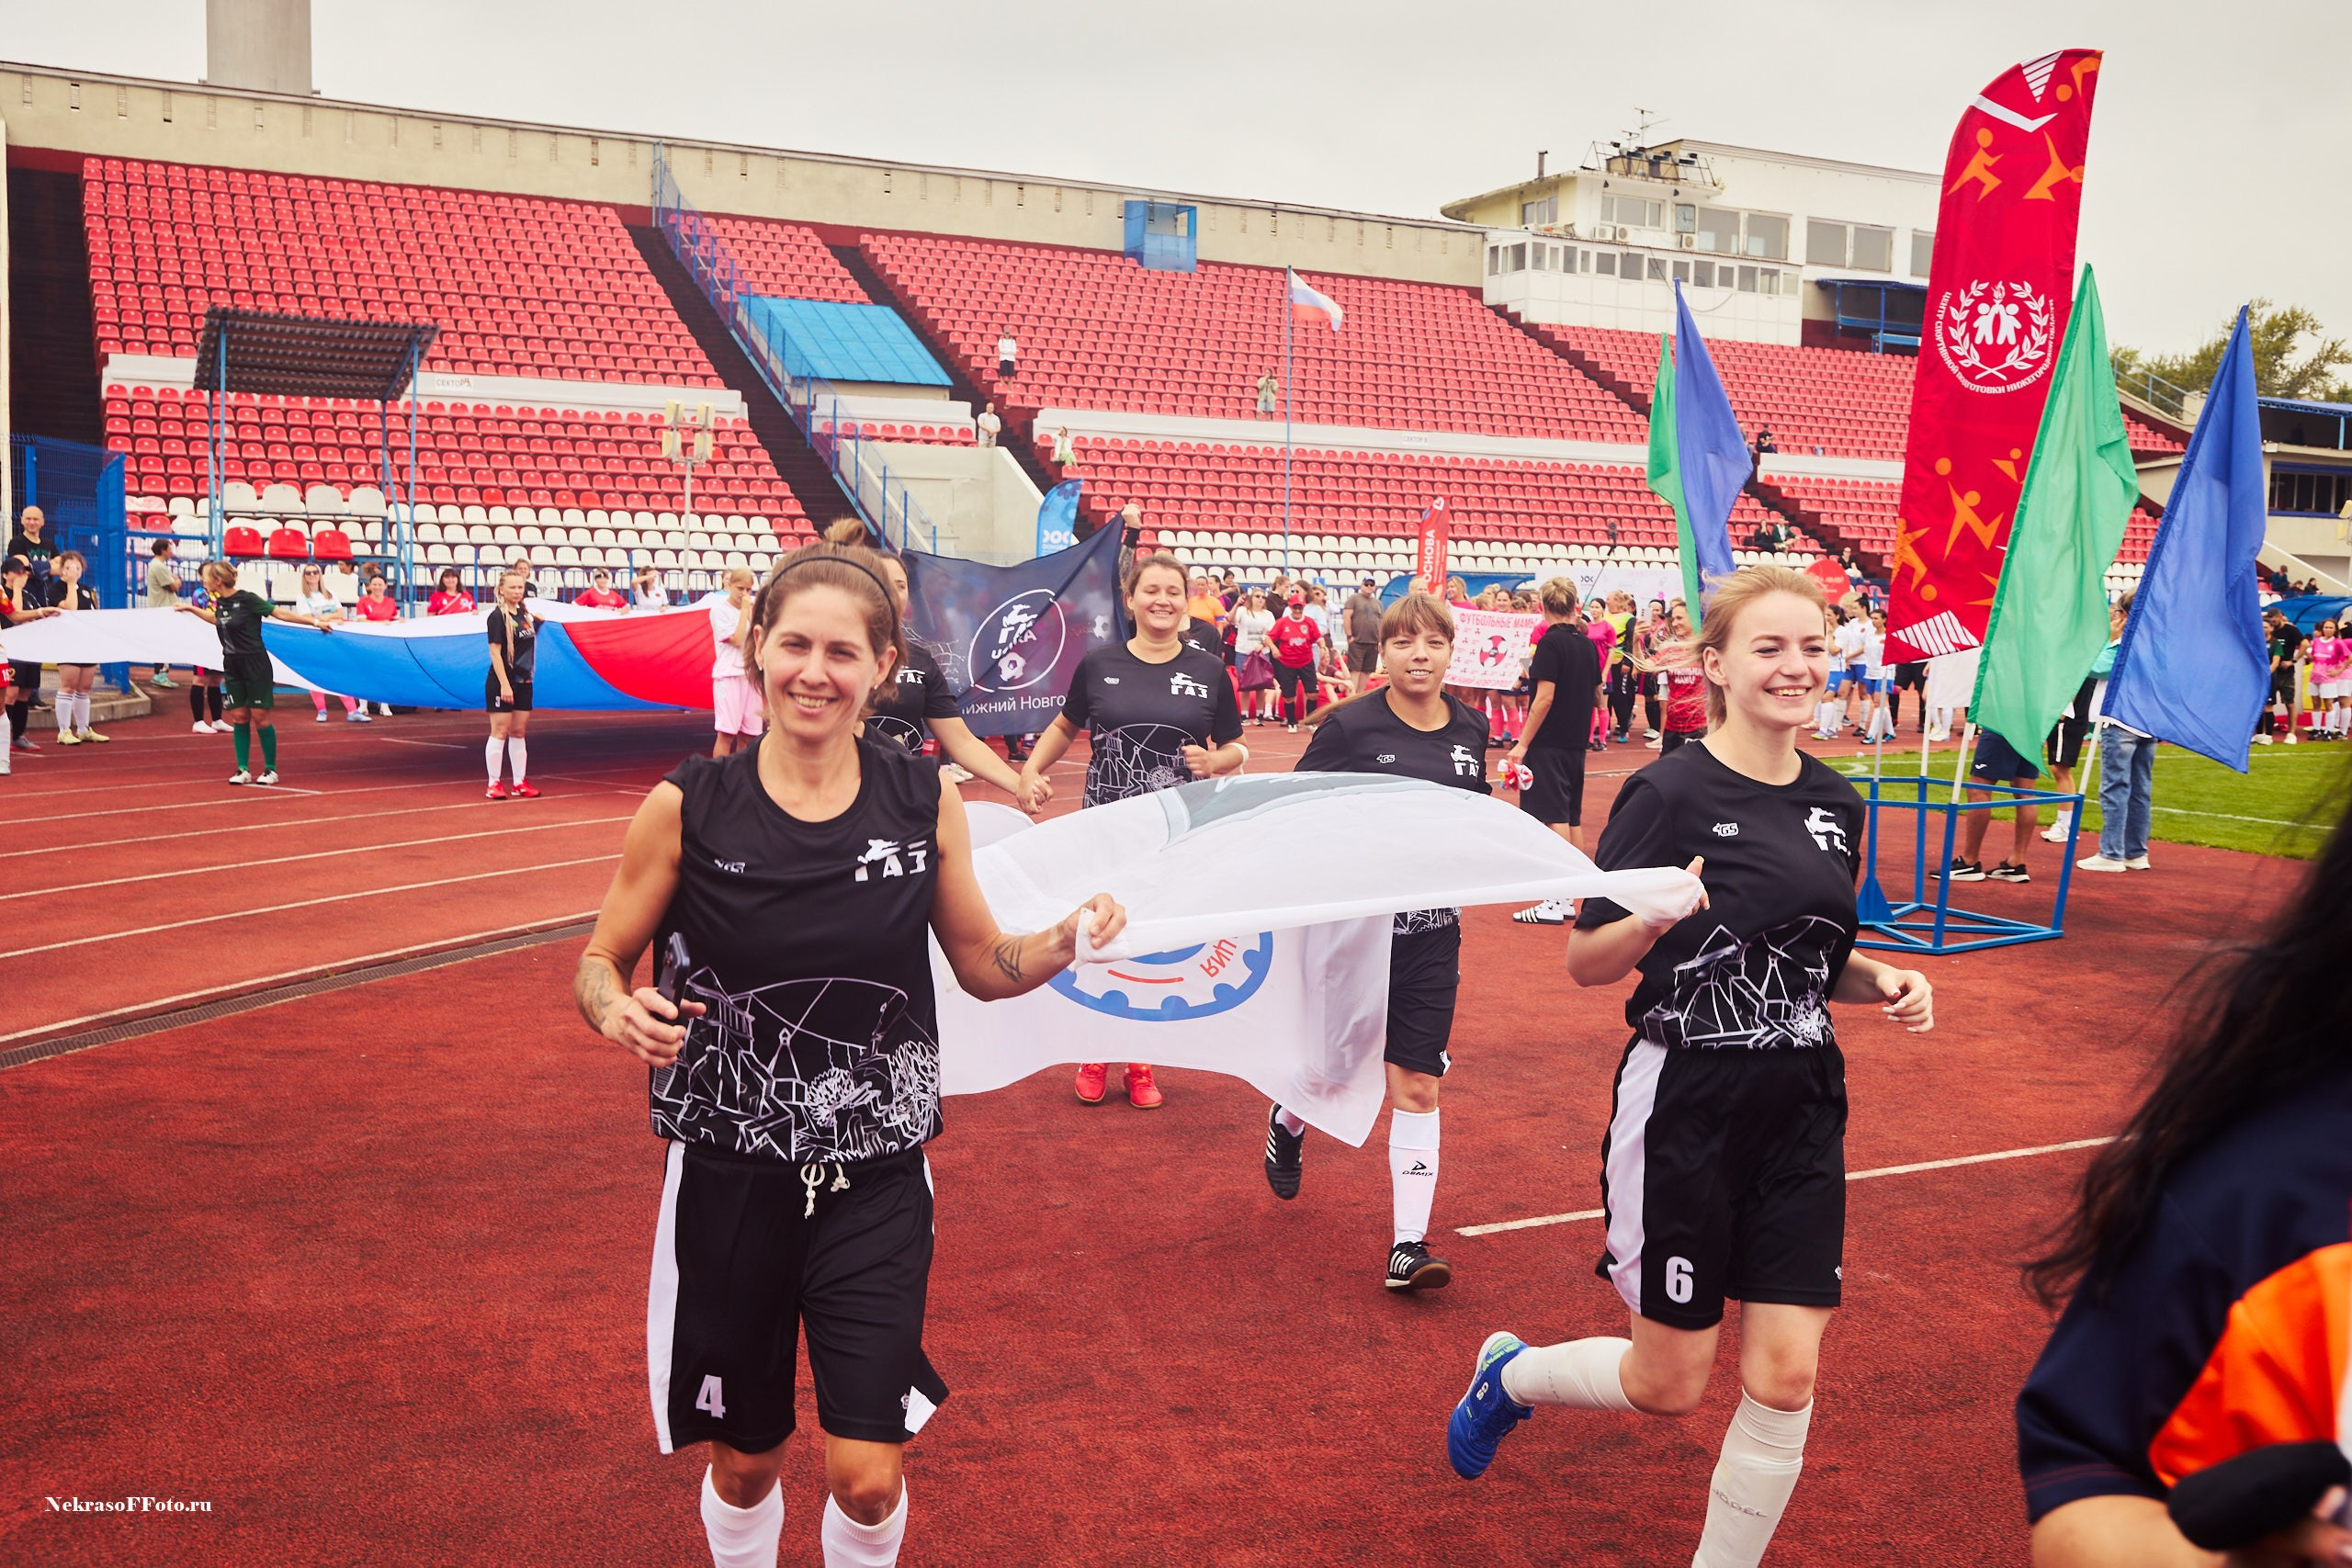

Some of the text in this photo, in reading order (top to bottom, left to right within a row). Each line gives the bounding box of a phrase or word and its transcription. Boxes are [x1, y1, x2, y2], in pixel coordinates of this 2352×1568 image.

[1936, 291, 1952, 320] ЦЕНТР
[1934, 321, 1960, 375] СПОРТИВНОЙ
[1422, 528, 1435, 582] ОСНОВА
[1459, 613, 1511, 628] ФУТБОЛЬНЫЕ
[1020, 694, 1067, 710] Новго
[1171, 685, 1208, 698] ГАЗ
[1200, 936, 1238, 978] ЦИЯ
[1666, 1256, 1694, 1303] 6
[695, 1375, 726, 1419] 4
